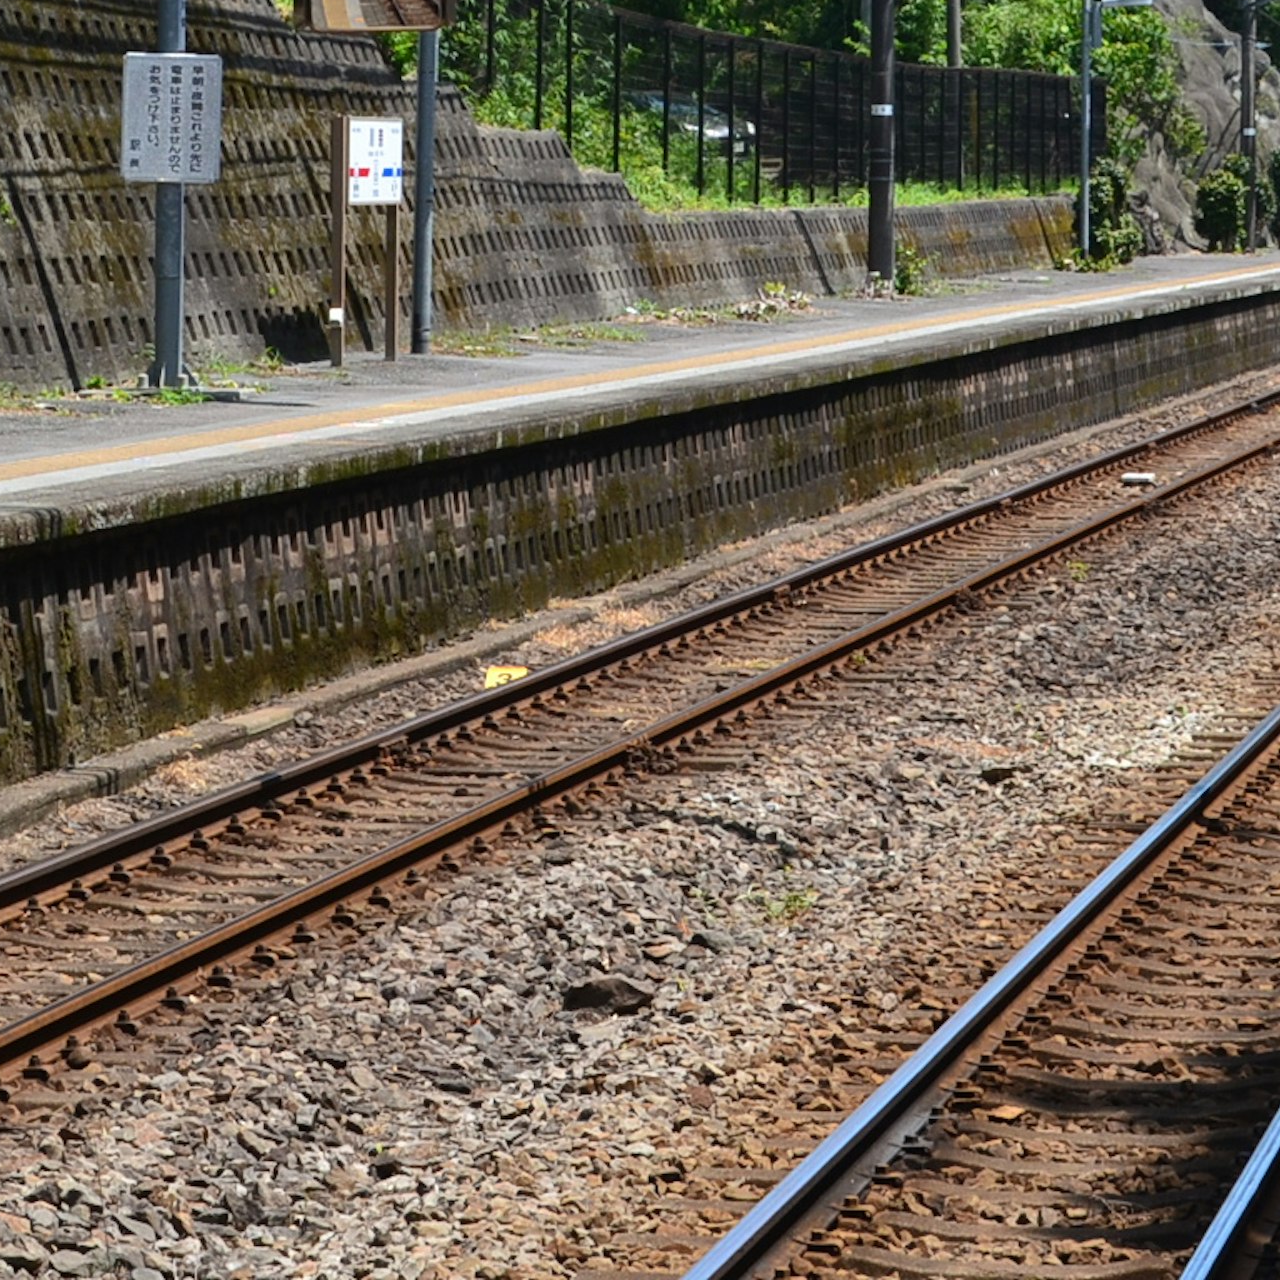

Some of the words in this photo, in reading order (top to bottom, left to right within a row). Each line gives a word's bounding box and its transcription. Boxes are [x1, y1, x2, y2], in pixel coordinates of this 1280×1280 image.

[168, 64, 183, 173] 電車は止まりませんので
